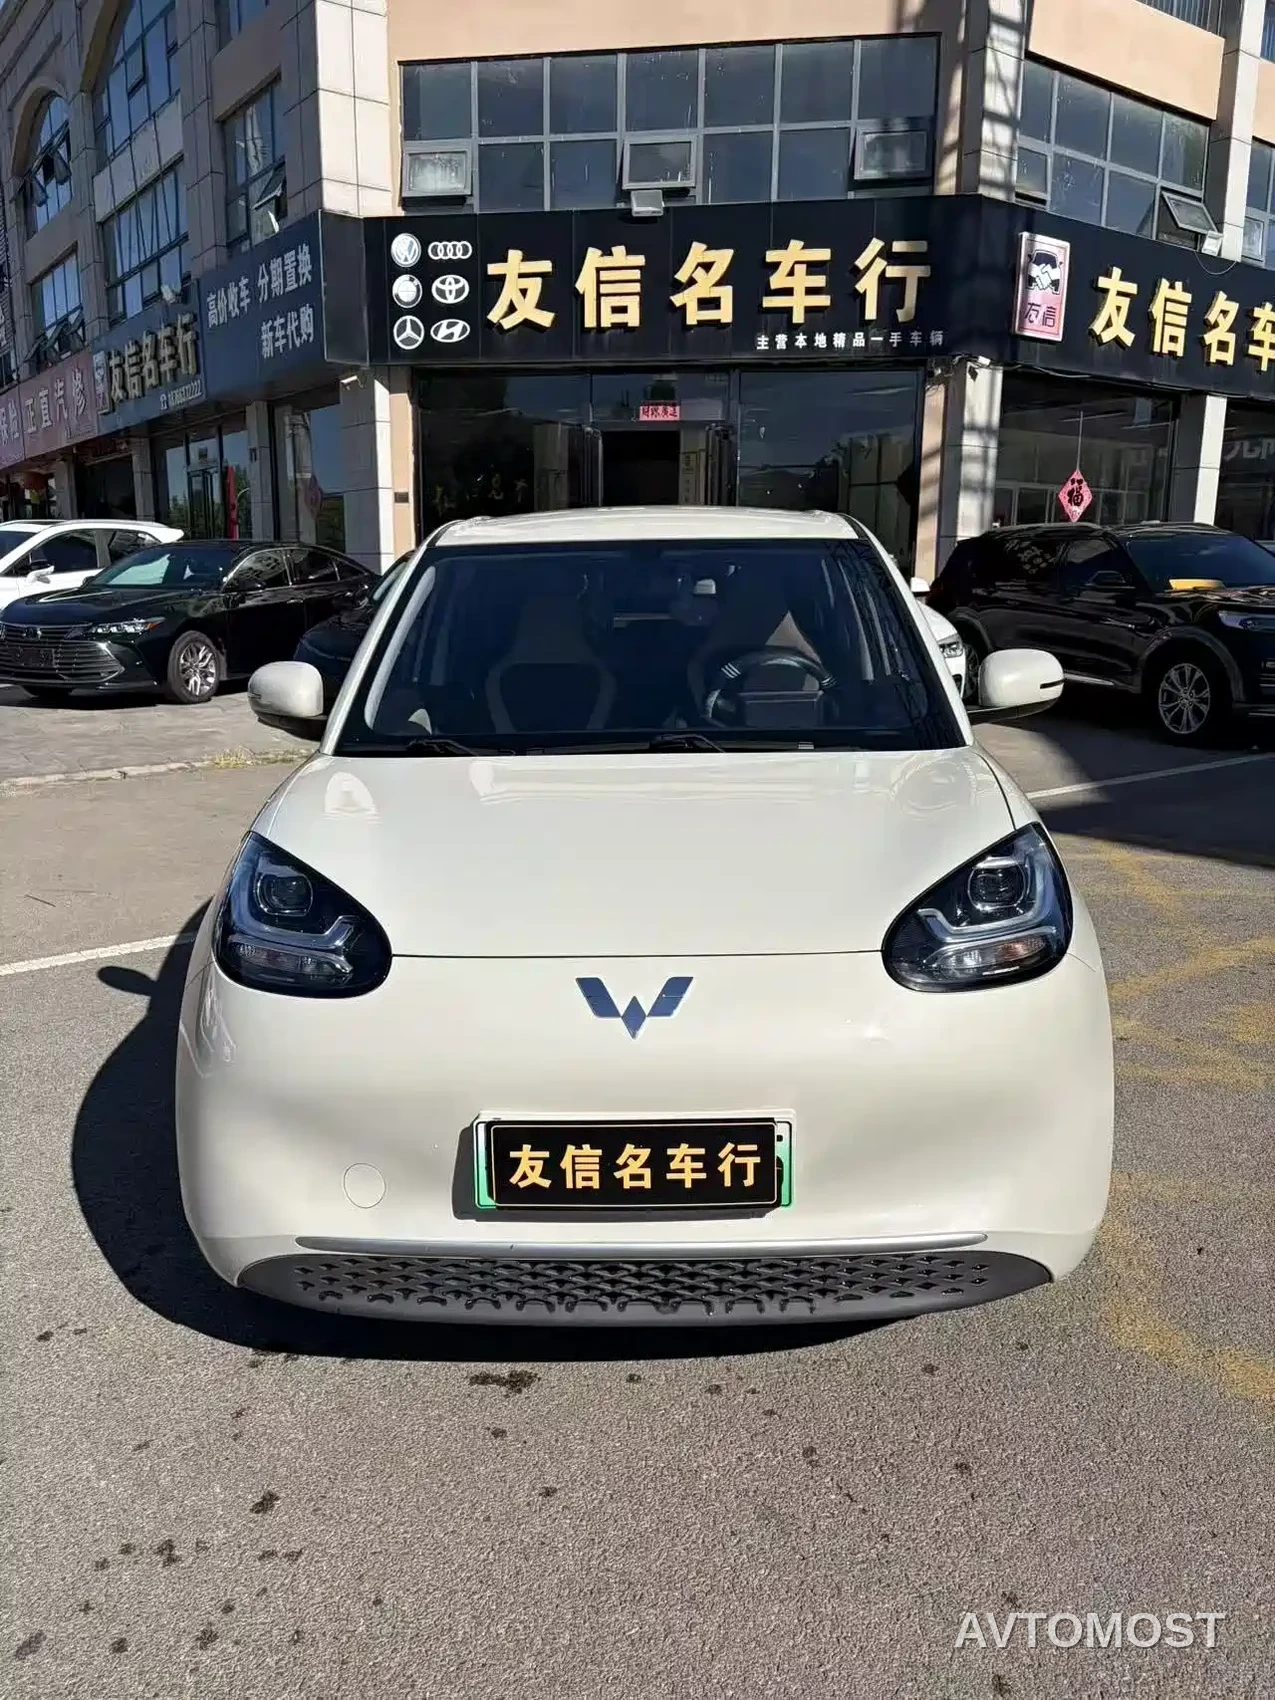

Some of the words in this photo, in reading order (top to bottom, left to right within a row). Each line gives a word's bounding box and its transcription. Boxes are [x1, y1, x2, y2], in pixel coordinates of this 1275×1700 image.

[206, 276, 250, 328] 高价收车
[258, 243, 312, 304] 分期置换
[485, 237, 932, 331] 友信名车行
[1089, 266, 1275, 372] 友信名车
[108, 313, 198, 402] 友信名车行
[261, 303, 314, 359] 新车代购
[756, 330, 944, 350] 主营本地精品一手车辆
[1067, 477, 1084, 507] 福
[508, 1142, 761, 1190] 友信名车行
